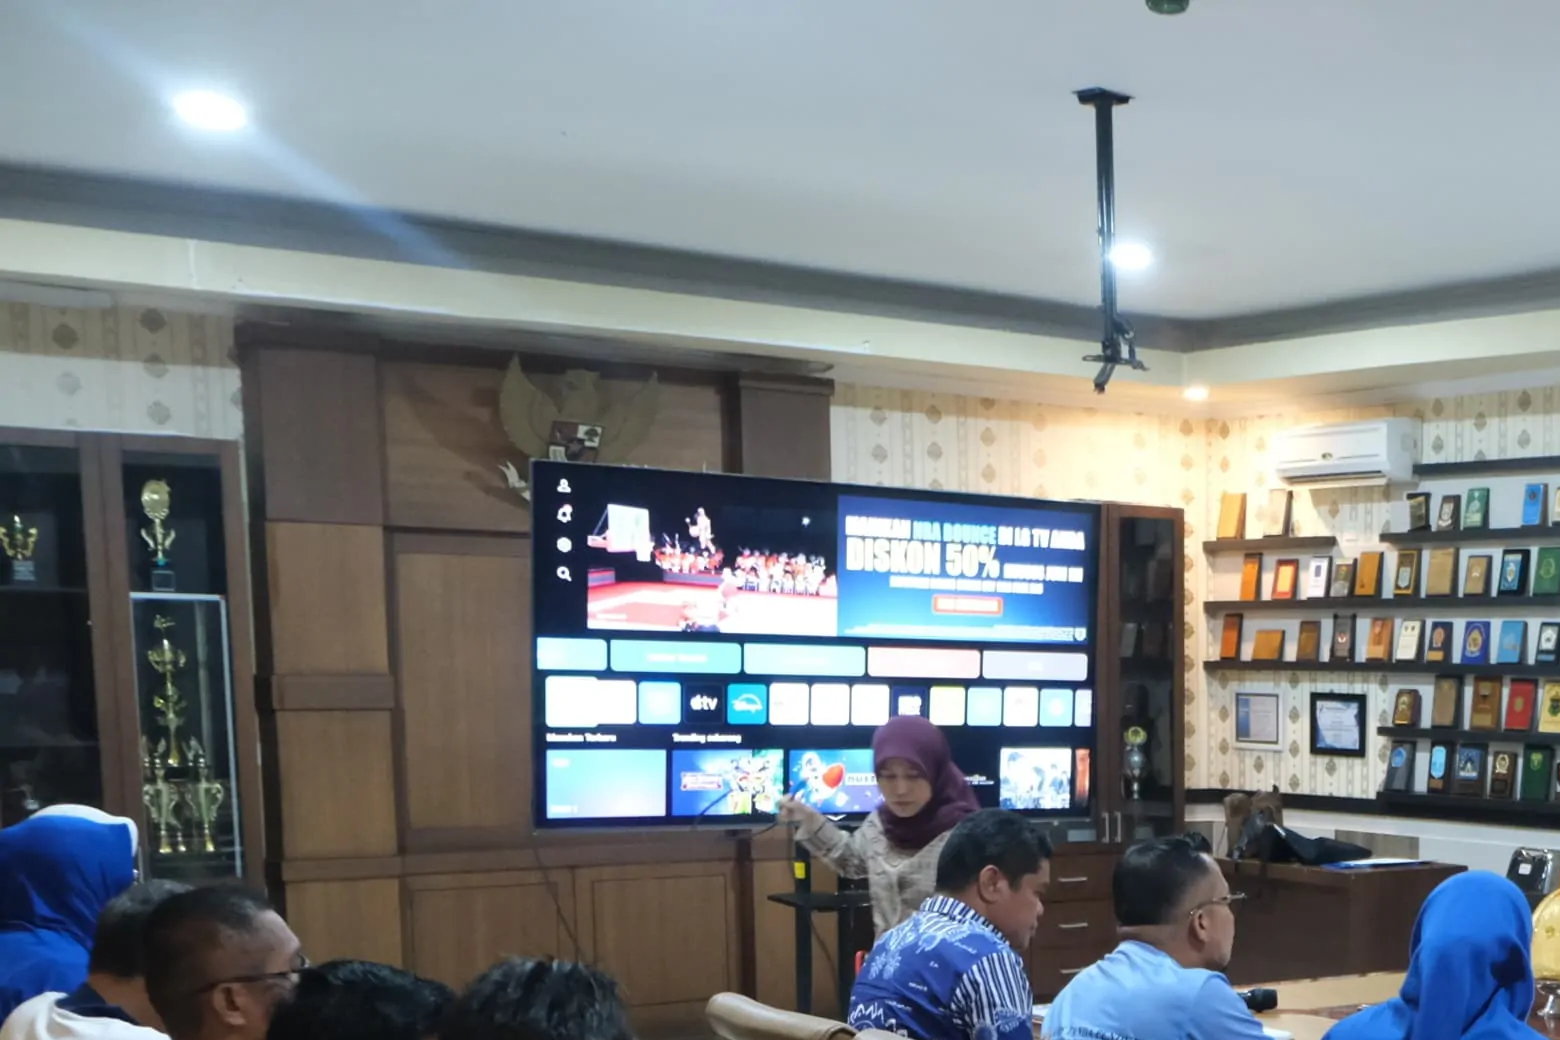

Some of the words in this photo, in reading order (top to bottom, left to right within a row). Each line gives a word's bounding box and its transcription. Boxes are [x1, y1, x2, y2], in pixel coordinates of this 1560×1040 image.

[1031, 528, 1050, 548] TV
[846, 537, 941, 575] DISKON
[945, 544, 1001, 578] 50%
